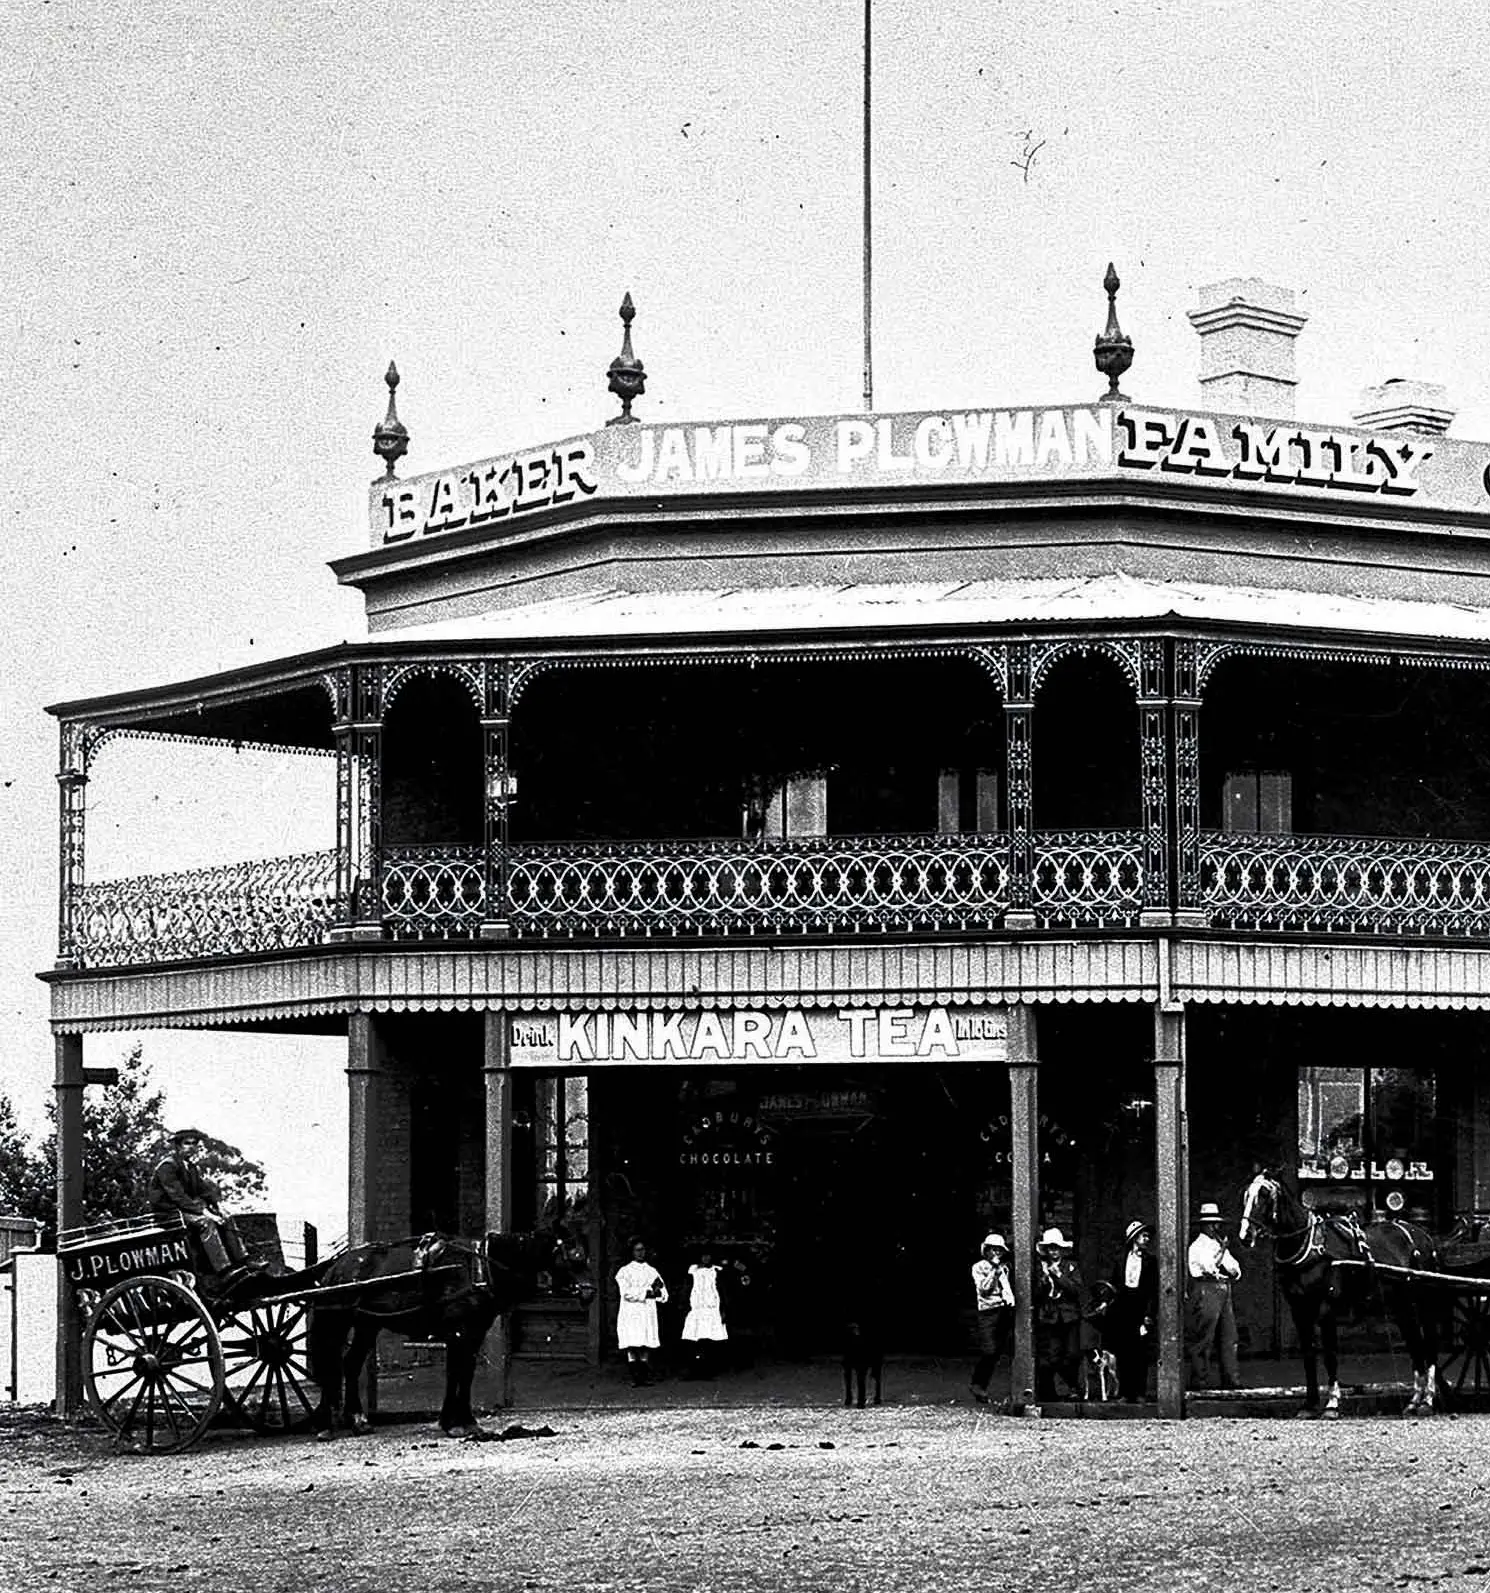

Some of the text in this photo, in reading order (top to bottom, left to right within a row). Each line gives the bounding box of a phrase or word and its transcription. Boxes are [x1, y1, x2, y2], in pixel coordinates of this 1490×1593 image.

[614, 408, 1113, 483] JAMES PLOWMAN
[1116, 409, 1434, 498] FAMILY
[380, 440, 598, 545] BAKER
[510, 1023, 554, 1048] Drink
[557, 1011, 817, 1062] KINKARA
[836, 1008, 961, 1058] TEA
[979, 1114, 1069, 1147] CADRYS
[995, 1151, 1052, 1164] COA
[679, 1152, 775, 1165] CHOCOLATE
